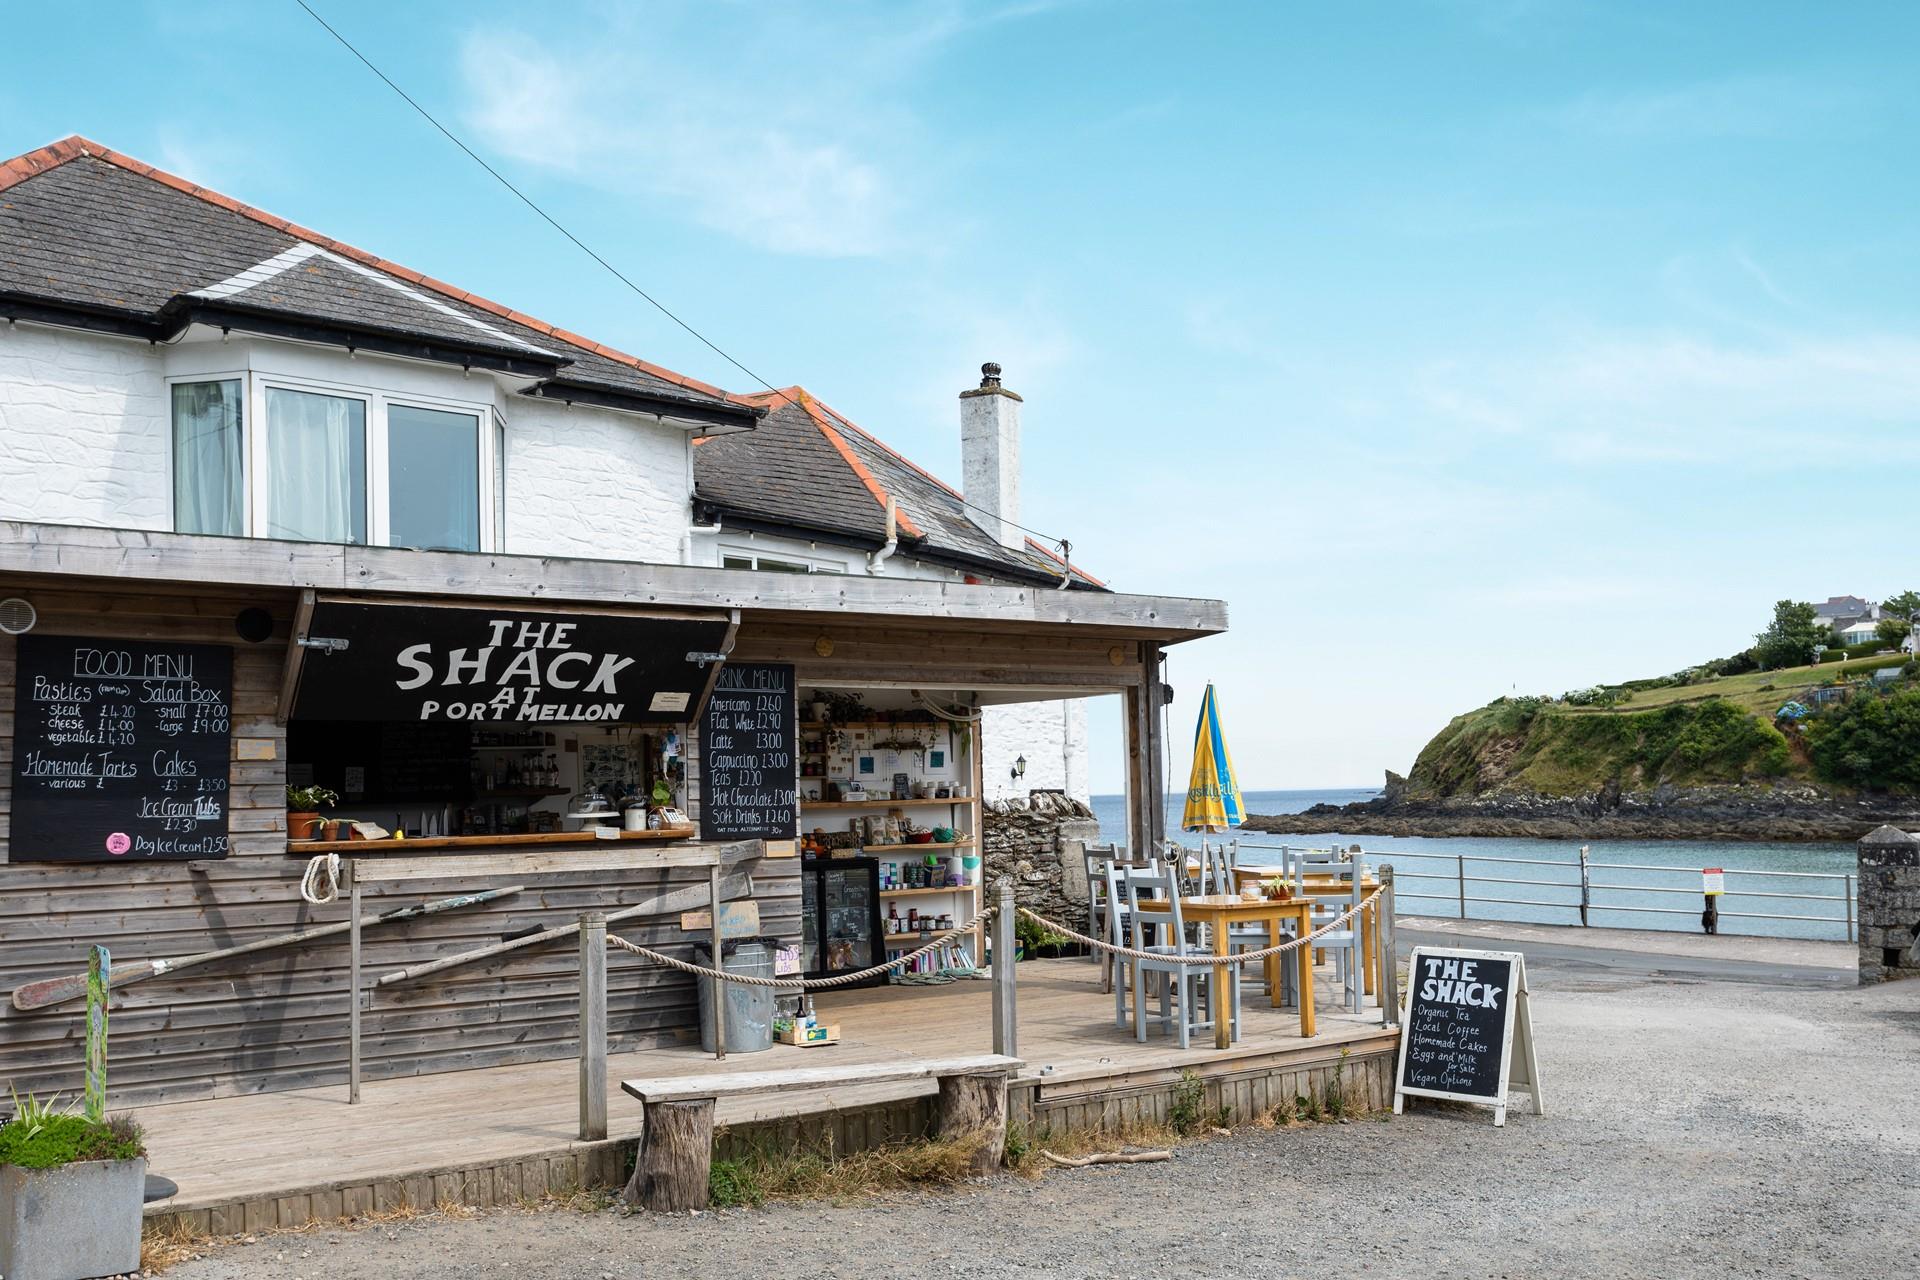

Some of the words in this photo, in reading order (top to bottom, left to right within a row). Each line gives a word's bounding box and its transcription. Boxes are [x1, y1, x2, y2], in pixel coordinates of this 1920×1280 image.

[488, 620, 577, 649] THE
[74, 648, 131, 676] FOOD
[144, 654, 192, 679] MENU
[396, 643, 636, 694] SHACK
[33, 675, 92, 701] Pasties
[752, 669, 786, 692] MENU
[139, 680, 183, 703] Salad
[191, 681, 222, 702] Box
[488, 687, 541, 704] AT
[709, 695, 751, 712] Americano
[710, 711, 730, 729] Flat
[734, 712, 756, 732] White
[47, 729, 96, 746] vegetable
[710, 731, 734, 750] Latte
[21, 750, 94, 776] Homemade
[98, 751, 138, 777] Tarts
[153, 749, 197, 776] Cakes
[709, 750, 759, 771] Cappuccino
[49, 778, 87, 789] various
[709, 768, 731, 786] Teas
[136, 796, 160, 818] Ice
[193, 796, 221, 818] Tubs
[709, 787, 729, 806] Hot
[730, 787, 773, 807] Chocolate
[711, 808, 733, 825] Soft
[735, 808, 761, 825] Drinks
[135, 835, 156, 856] Dog
[157, 837, 173, 853] Ice
[173, 837, 202, 853] Cream
[1424, 958, 1478, 982] THE
[1420, 978, 1503, 1010] SHACK
[1417, 1003, 1449, 1022] Organic
[1455, 1006, 1470, 1021] Tea
[1415, 1019, 1440, 1032] Local
[1447, 1022, 1480, 1038] Coffee
[1413, 1032, 1456, 1049] Homemade
[1459, 1037, 1488, 1053] Cakes
[1411, 1046, 1435, 1063] Eggs
[1437, 1052, 1455, 1063] and
[1457, 1053, 1478, 1065] Milk
[1446, 1061, 1458, 1073] for
[1459, 1062, 1476, 1074] Sale
[1411, 1068, 1437, 1087] Vegan
[1440, 1071, 1473, 1089] Options
